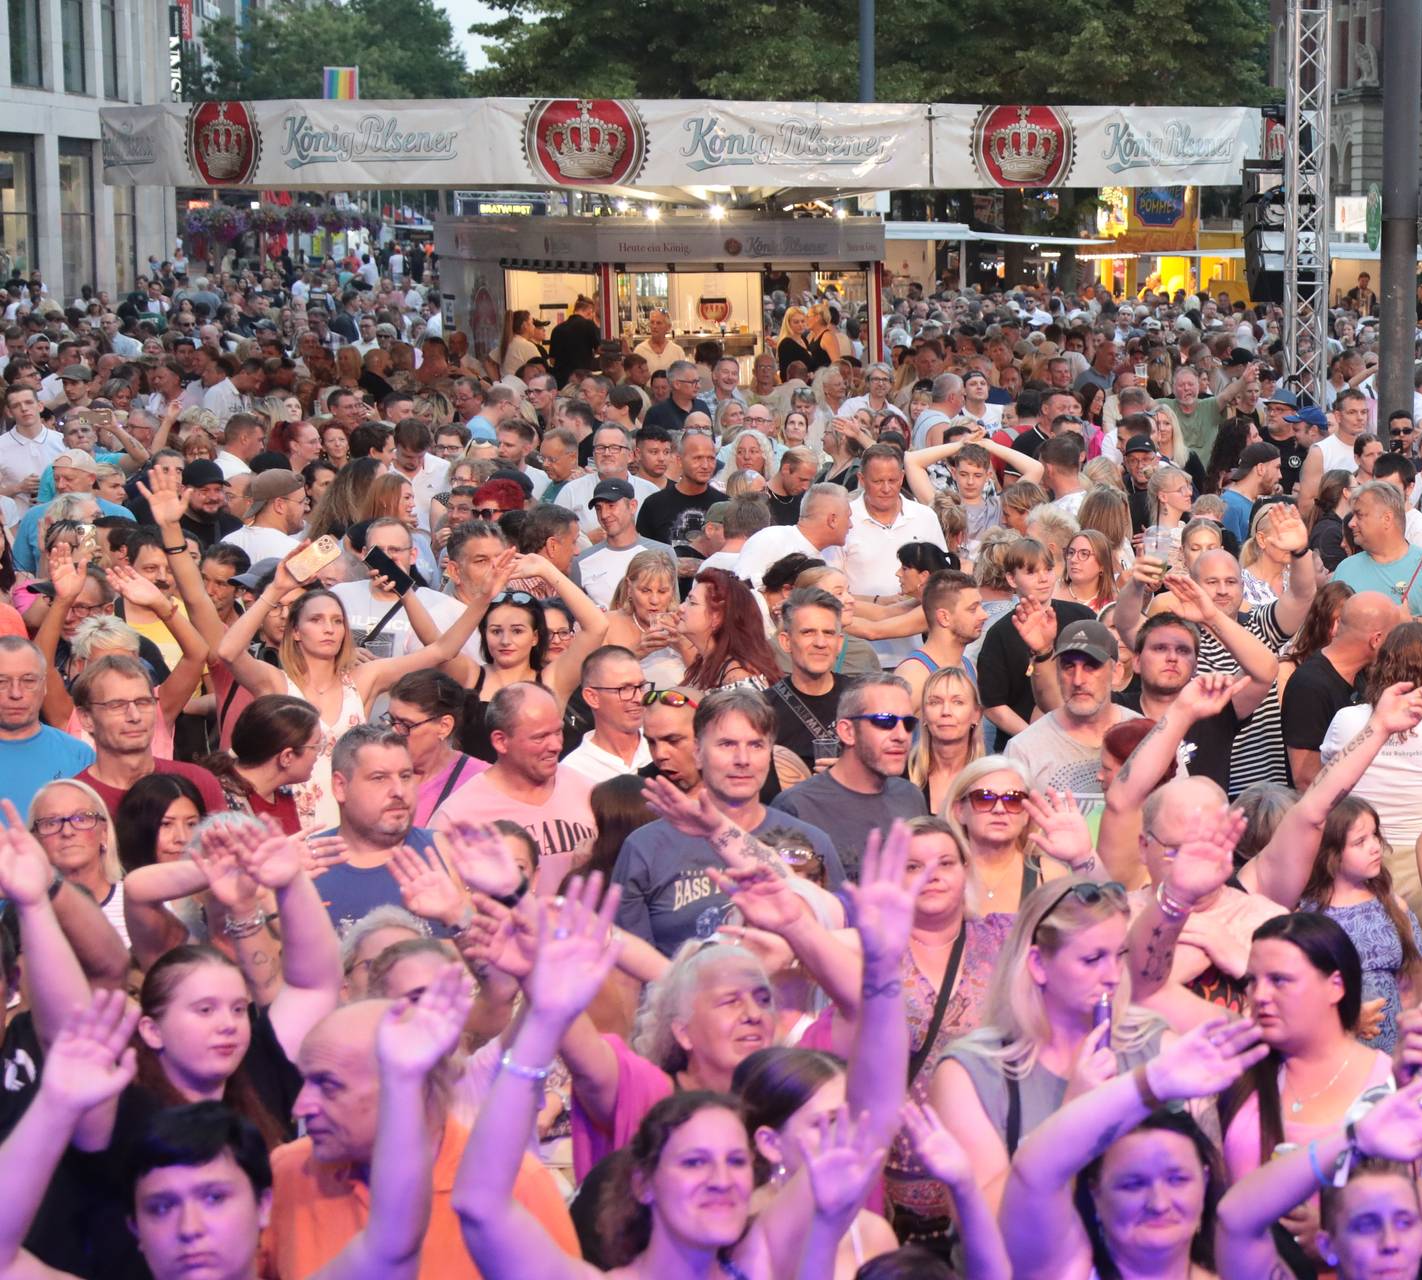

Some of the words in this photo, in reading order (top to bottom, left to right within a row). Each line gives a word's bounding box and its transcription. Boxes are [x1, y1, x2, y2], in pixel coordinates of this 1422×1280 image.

[280, 115, 355, 164] König
[354, 114, 458, 157] Pilsener
[680, 117, 774, 164] König
[774, 118, 893, 160] Pilsener
[1102, 121, 1164, 166] König
[1163, 119, 1236, 158] Pilsener
[1140, 199, 1177, 213] POMMES
[673, 876, 711, 912] BASS
